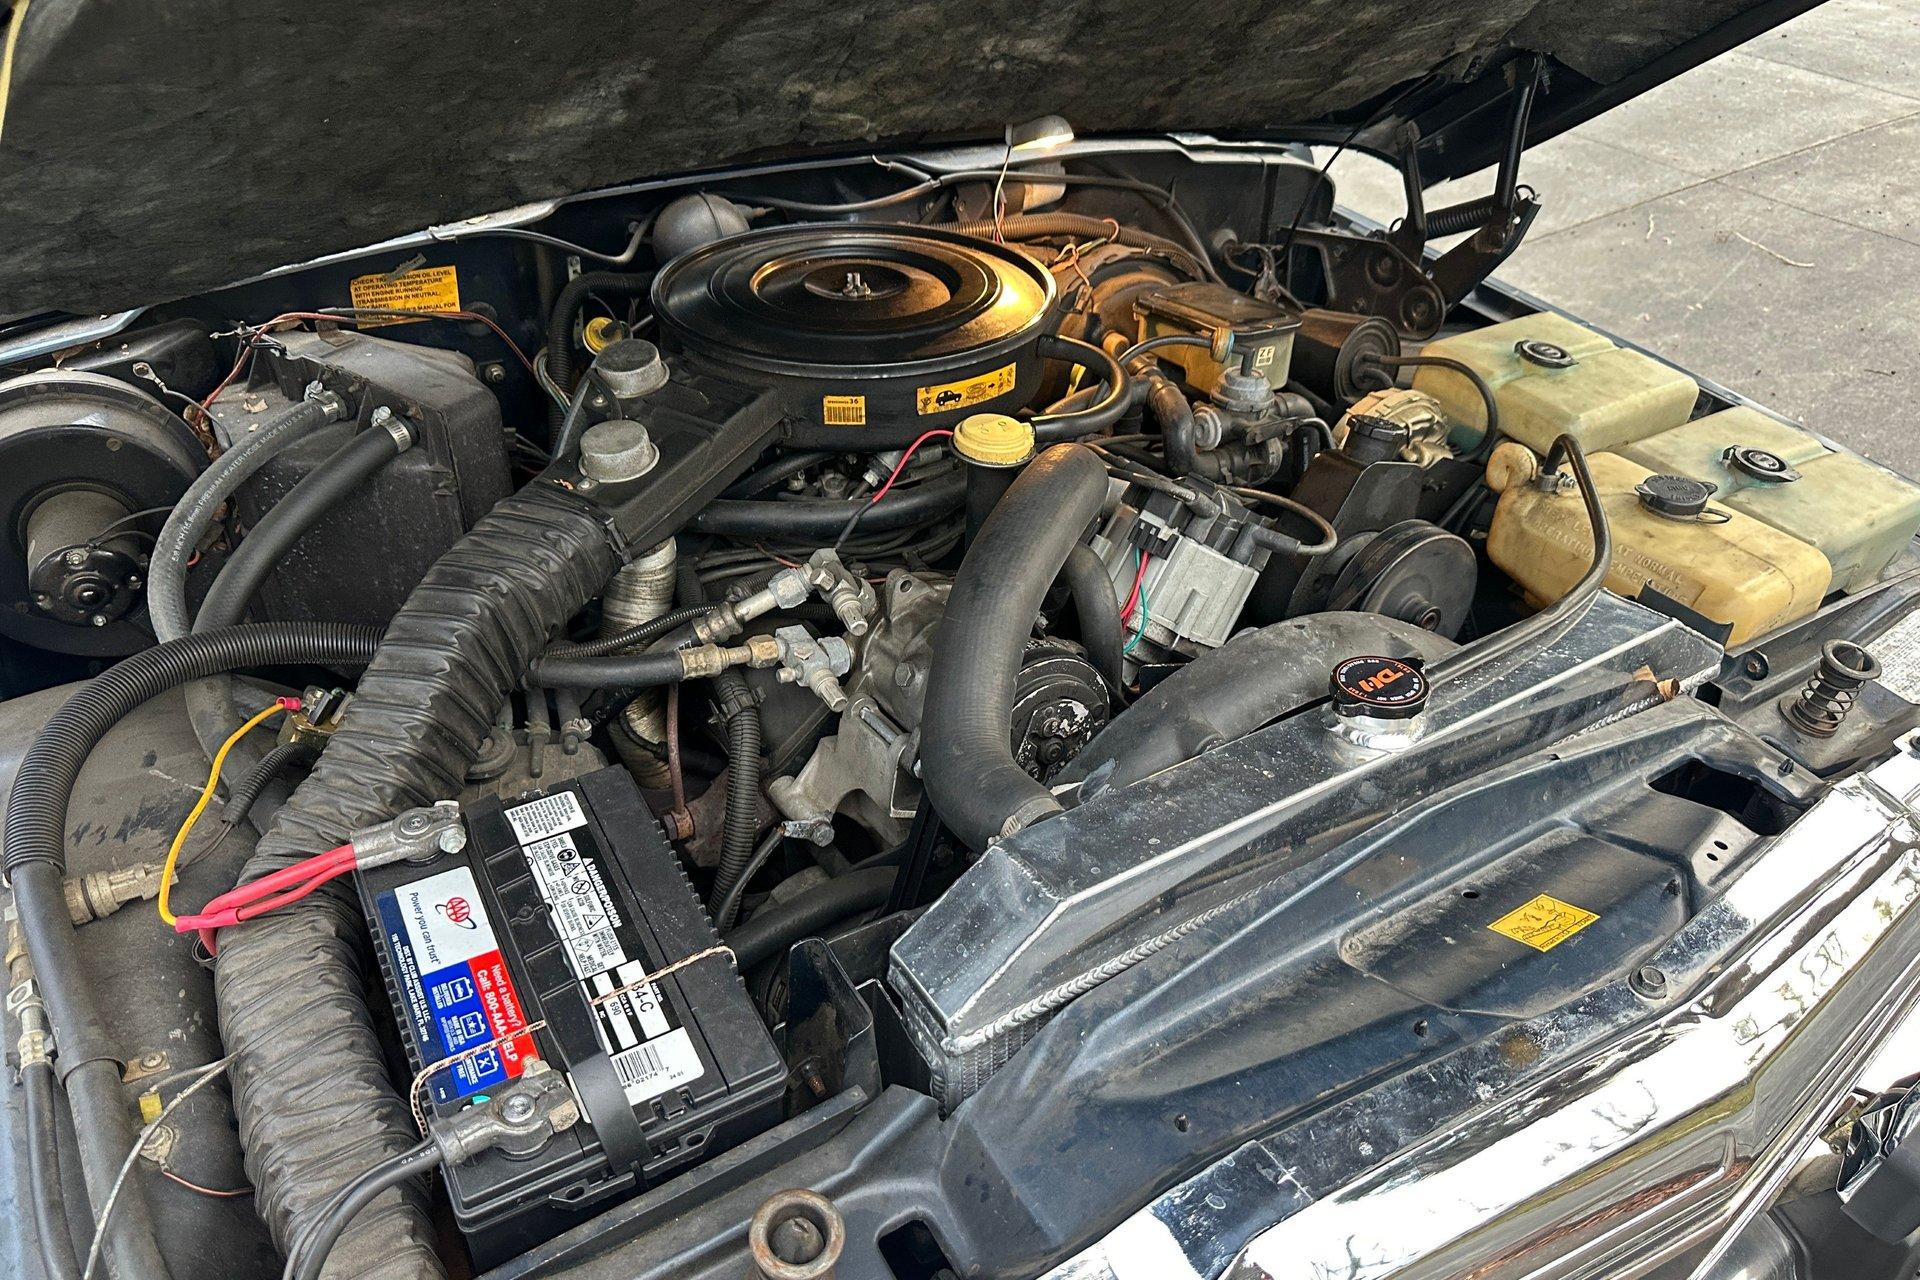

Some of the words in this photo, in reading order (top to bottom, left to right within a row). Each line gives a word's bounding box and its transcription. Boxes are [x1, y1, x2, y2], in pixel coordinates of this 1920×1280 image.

[352, 278, 375, 286] CHECK
[355, 291, 371, 299] WITH
[371, 289, 394, 297] ENGINE
[395, 285, 423, 294] RUNNING
[363, 281, 399, 291] OPERATING
[399, 277, 443, 287] TEMPERATURE
[417, 303, 443, 311] MANUAL
[197, 475, 224, 506] PREMIUM
[218, 453, 247, 480] HEATER
[241, 439, 263, 459] HOSE
[259, 426, 280, 446] MADE
[1613, 541, 1633, 559] AT
[1632, 551, 1685, 587] NORMAL
[408, 890, 425, 915] Power
[585, 862, 623, 929] DANGER/POISON
[444, 897, 471, 924] AAA
[413, 913, 428, 931] you
[420, 928, 432, 945] can
[405, 956, 414, 965] BY
[393, 940, 409, 975] TECHNOLOGY
[407, 988, 418, 1004] LAKE
[407, 964, 418, 979] CLUB
[476, 968, 493, 991] Call:
[489, 963, 506, 987] Need
[497, 986, 507, 995] a
[498, 992, 522, 1029] battery?
[608, 1000, 622, 1016] 690
[450, 1014, 460, 1029] MADE
[456, 1033, 466, 1045] USA
[483, 989, 518, 1064] 800-AAA-ELP
[455, 1063, 466, 1079] FREE
